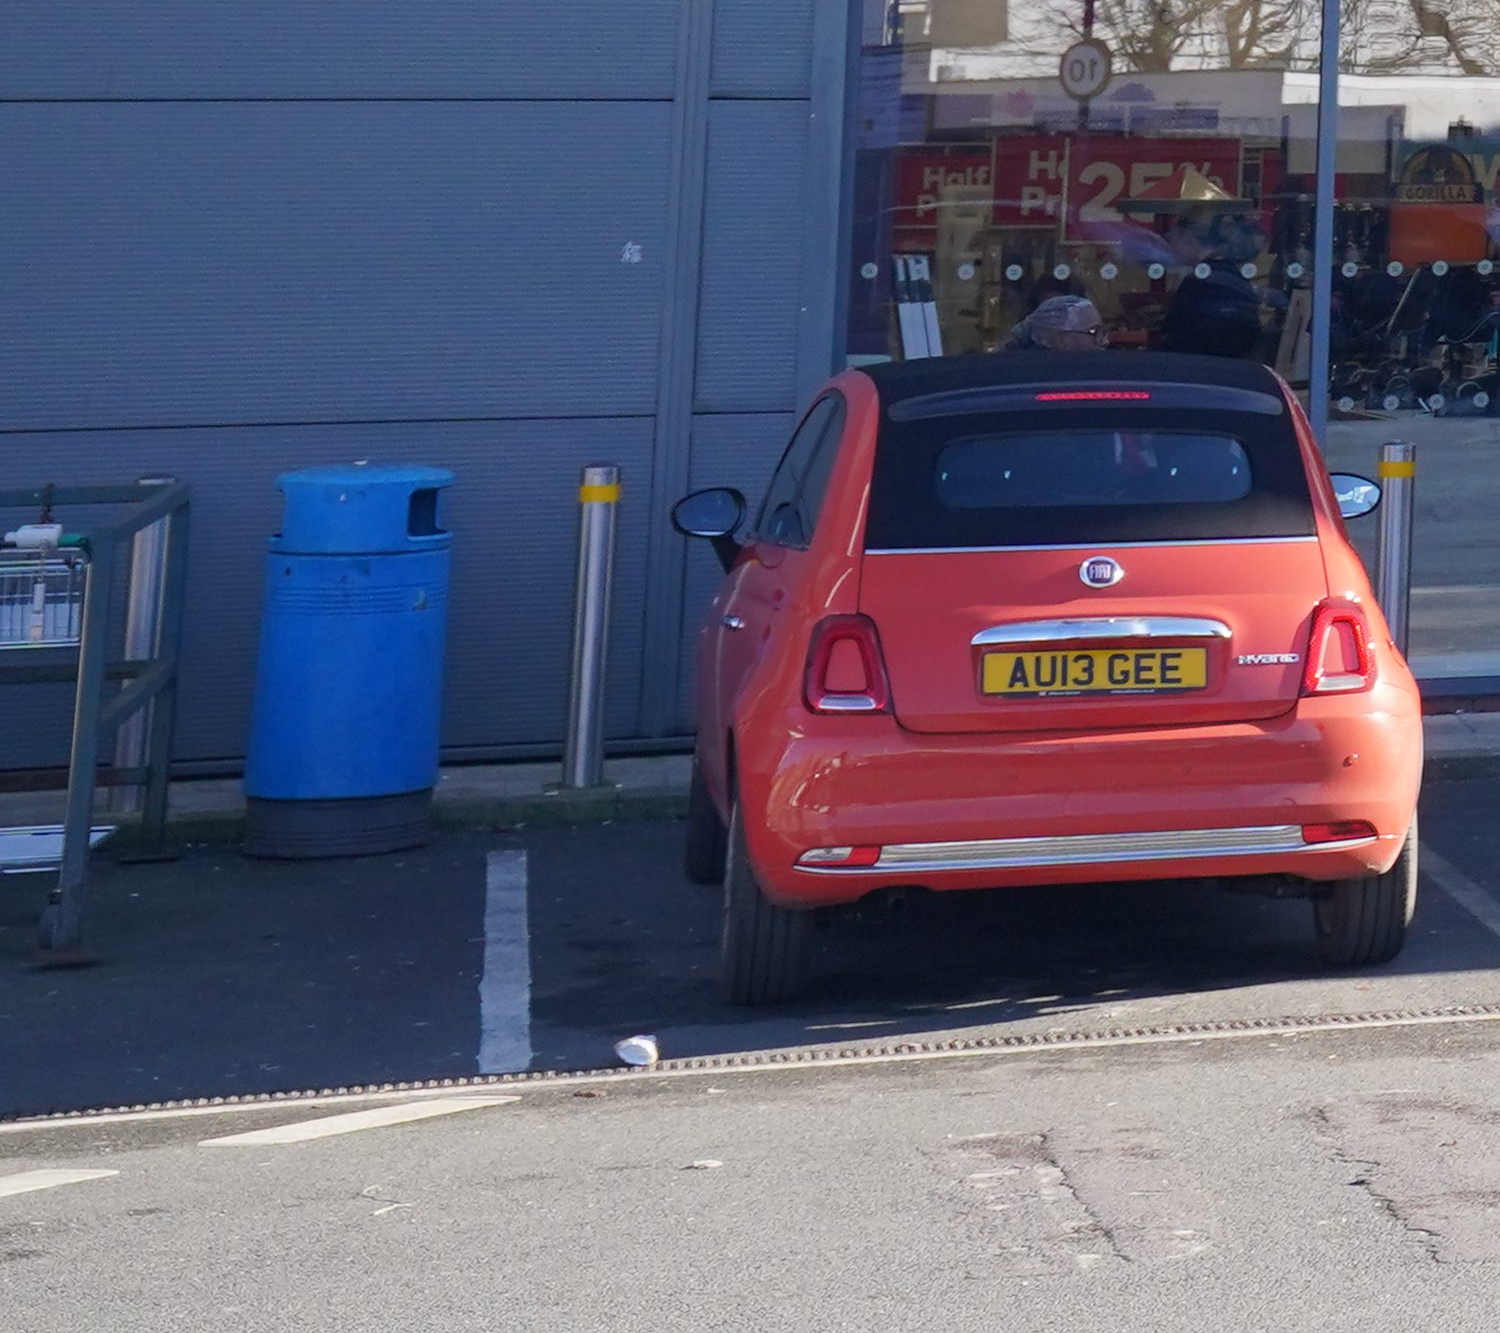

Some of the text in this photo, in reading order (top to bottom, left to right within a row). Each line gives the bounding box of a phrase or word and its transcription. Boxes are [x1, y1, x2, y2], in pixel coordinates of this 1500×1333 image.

[1405, 185, 1467, 200] GORILLA
[1089, 564, 1112, 581] FIAT
[1237, 653, 1300, 666] HYBRID
[1008, 652, 1183, 688] AU13 GEE
